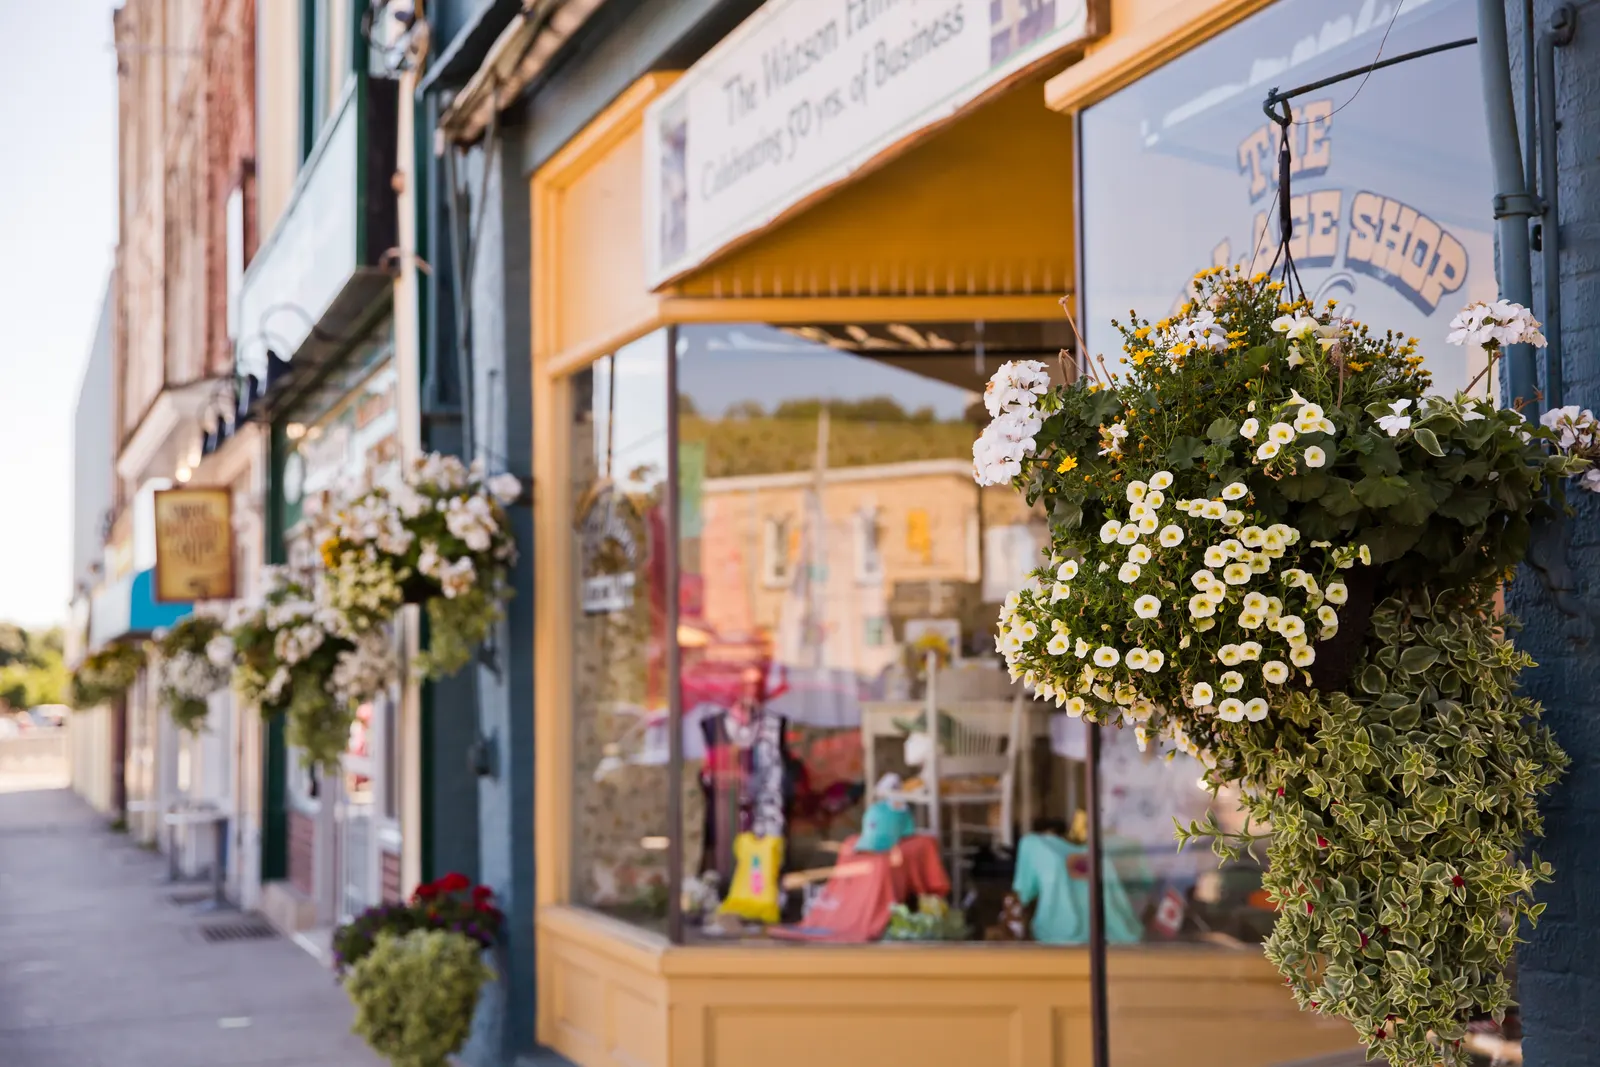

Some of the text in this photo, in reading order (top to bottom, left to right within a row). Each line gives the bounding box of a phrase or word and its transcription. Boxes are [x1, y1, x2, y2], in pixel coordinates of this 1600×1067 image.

[722, 73, 756, 127] The
[760, 19, 838, 98] Watson
[787, 99, 812, 161] 50
[849, 53, 868, 106] of
[874, 1, 964, 88] Business
[1238, 98, 1334, 203] THE
[1345, 189, 1469, 316] SHOP
